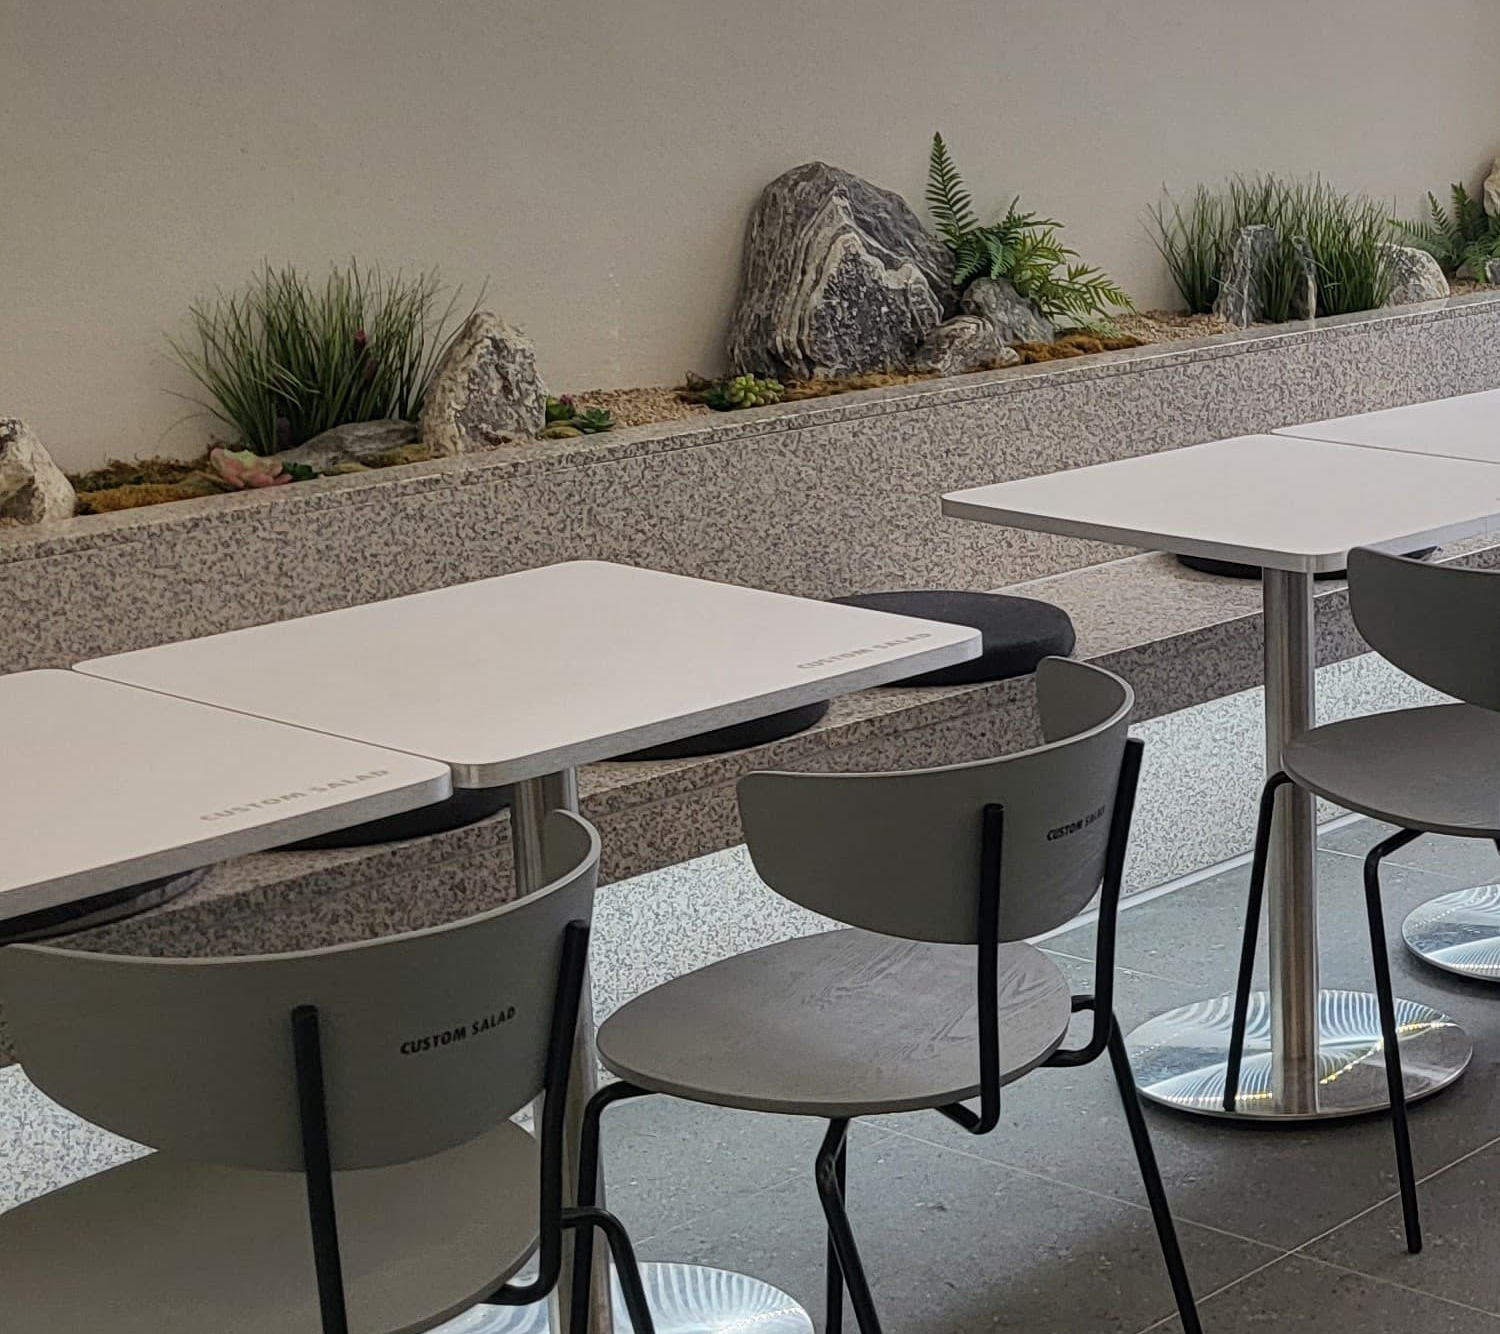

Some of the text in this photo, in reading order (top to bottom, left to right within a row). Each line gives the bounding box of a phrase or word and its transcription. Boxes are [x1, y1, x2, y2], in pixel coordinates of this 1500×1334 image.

[200, 768, 390, 821] CUSTOM SALAD
[400, 1006, 516, 1055] CUSTOM SALAD
